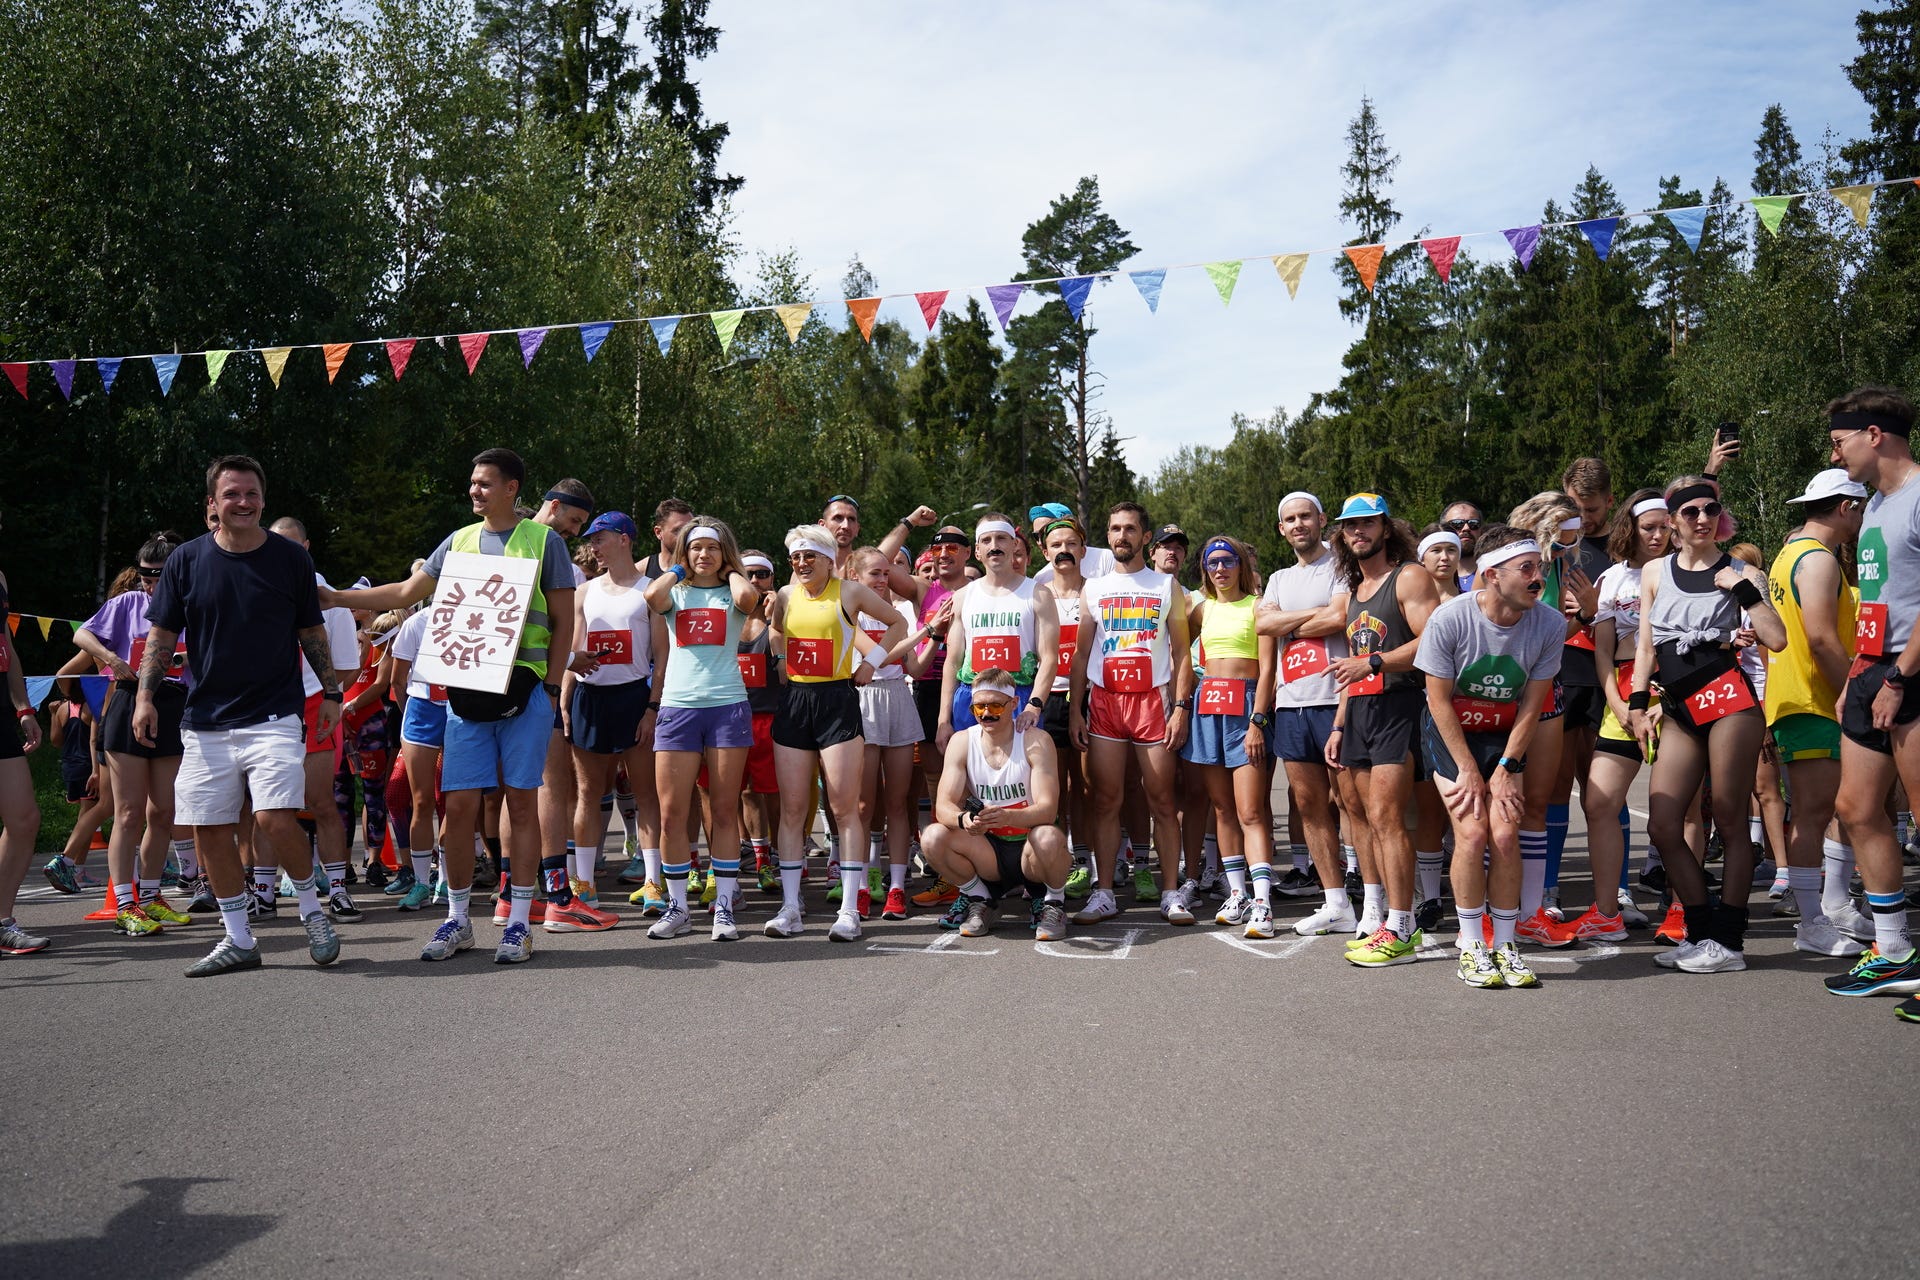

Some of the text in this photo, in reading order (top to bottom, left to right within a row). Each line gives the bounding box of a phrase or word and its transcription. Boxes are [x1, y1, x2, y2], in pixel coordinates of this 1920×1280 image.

[1861, 549, 1876, 561] GO
[1857, 562, 1880, 580] PRE
[971, 612, 1020, 628] IZMYLONG
[1098, 596, 1162, 632] TIME
[688, 620, 713, 633] 7-2
[595, 641, 624, 654] 15-2
[1101, 629, 1158, 656] DYNAMIC
[440, 641, 486, 670] БЕГ
[797, 651, 818, 664] 7-1
[980, 647, 1009, 661] 12-1
[1286, 649, 1318, 670] 22-2
[1112, 668, 1141, 681] 17-1
[1482, 674, 1505, 686] GO
[1205, 690, 1233, 703] 22-1
[1468, 682, 1513, 699] PRE
[1695, 683, 1738, 710] 29-2
[1461, 711, 1501, 726] 29-1
